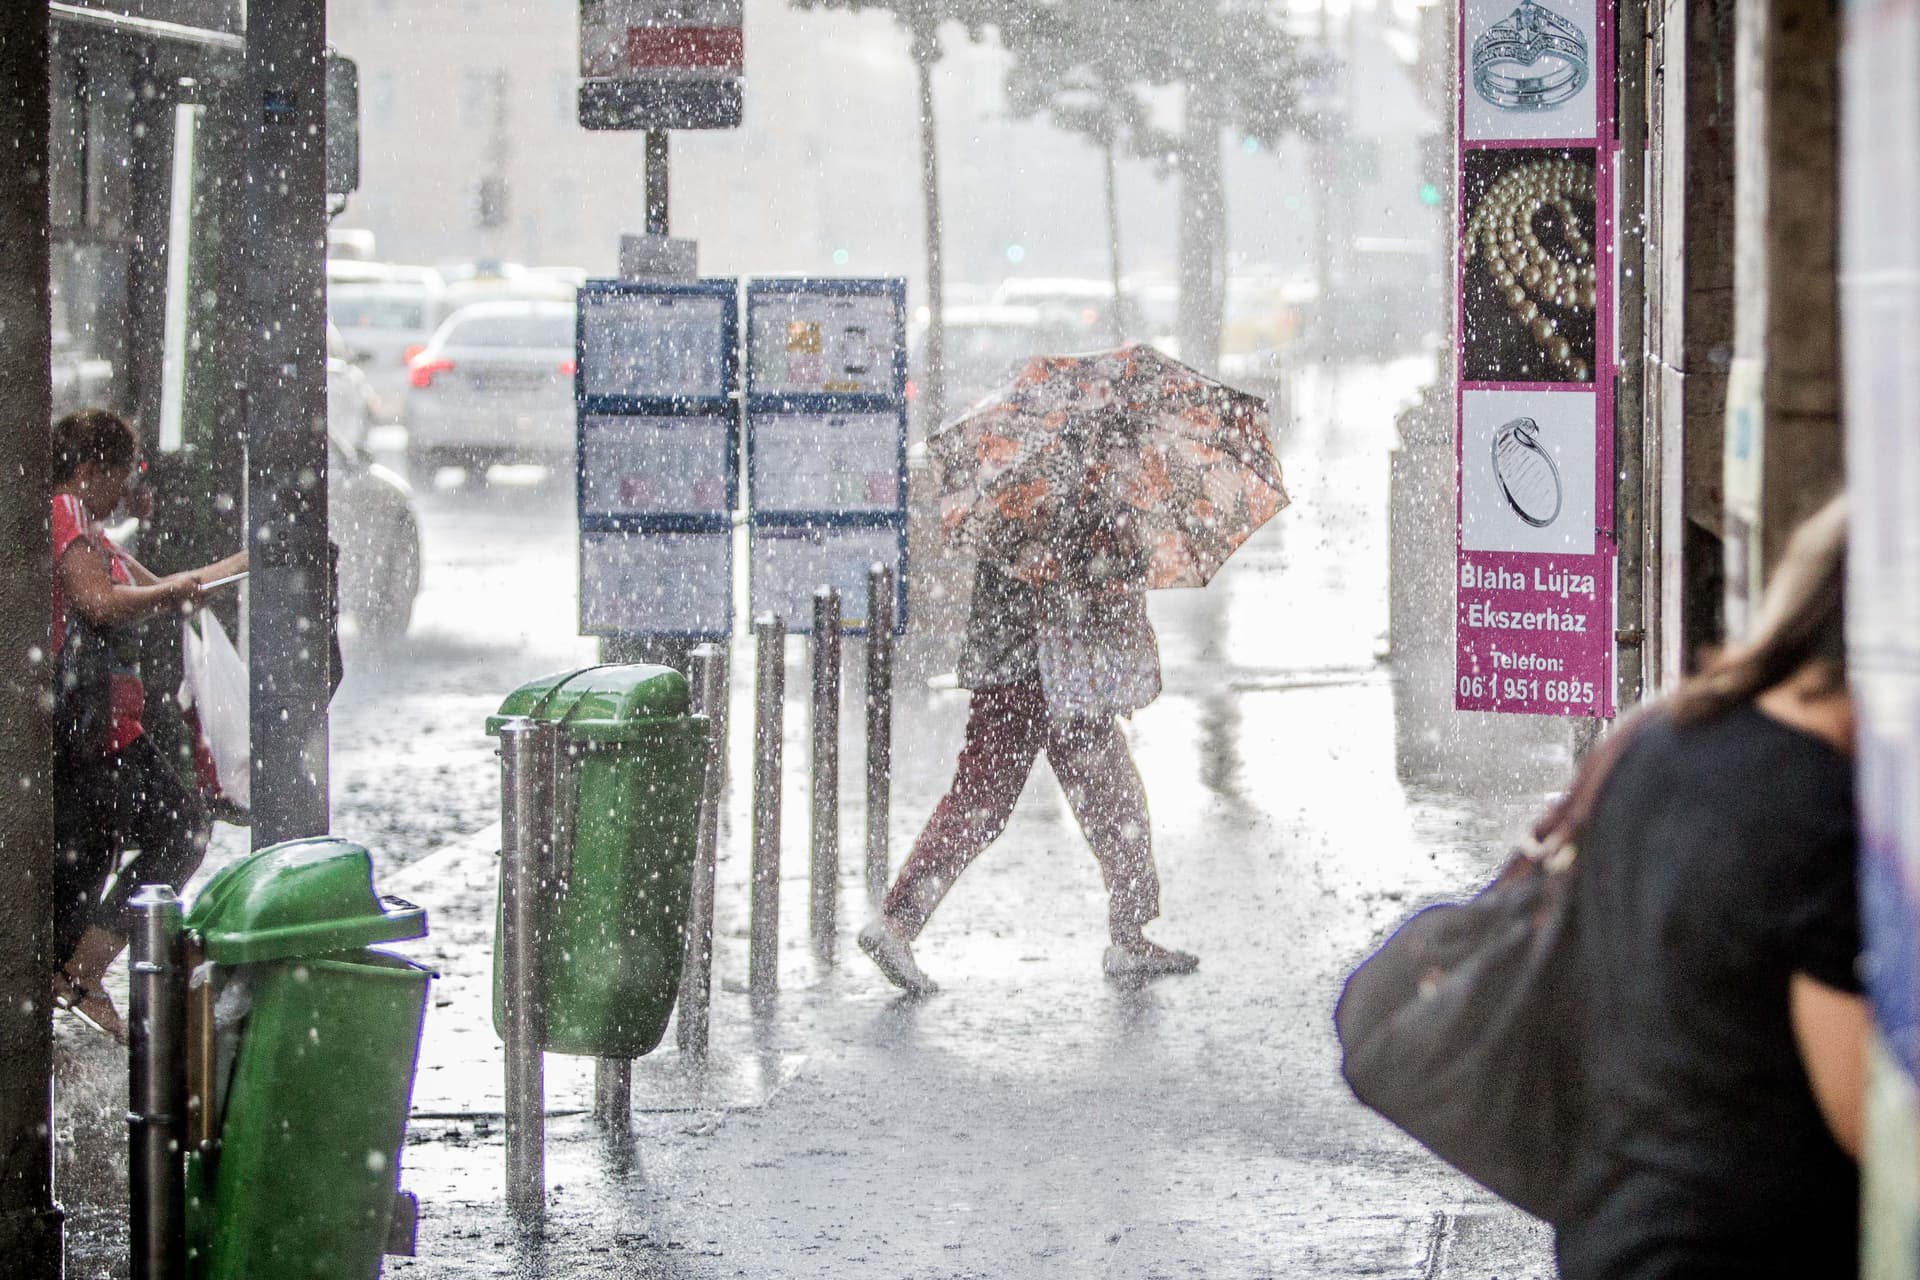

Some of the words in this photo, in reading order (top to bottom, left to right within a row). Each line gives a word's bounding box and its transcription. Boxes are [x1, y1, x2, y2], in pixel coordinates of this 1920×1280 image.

[1461, 564, 1525, 590] Blaha
[1534, 567, 1595, 598] Lujza
[1468, 599, 1587, 632] Ékszerház
[1490, 651, 1564, 671] Telefon:
[1460, 676, 1482, 698] 06
[1488, 677, 1498, 698] 1
[1504, 678, 1539, 700] 951
[1545, 681, 1594, 703] 6825
